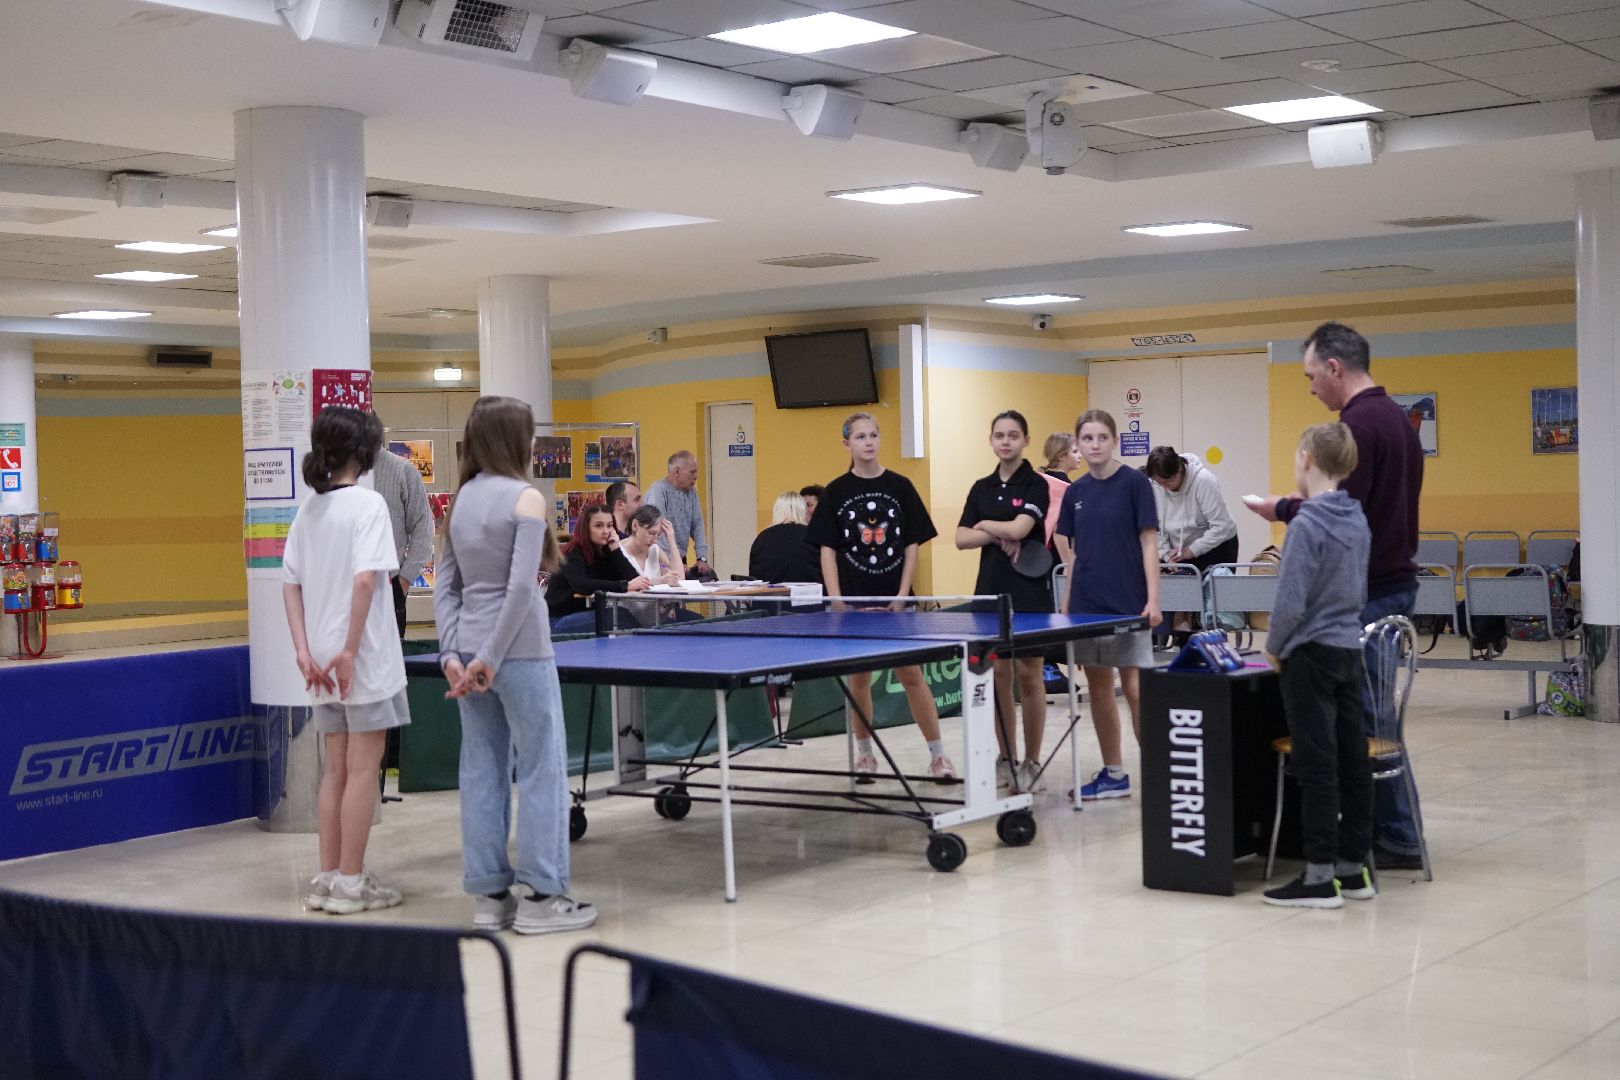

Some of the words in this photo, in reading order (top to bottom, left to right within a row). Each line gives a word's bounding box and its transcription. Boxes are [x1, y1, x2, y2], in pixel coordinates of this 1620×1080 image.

[22, 734, 170, 785] START
[179, 722, 255, 761] LINE
[1168, 708, 1206, 858] BUTTERFLY
[16, 788, 103, 812] www.start-line.ru
